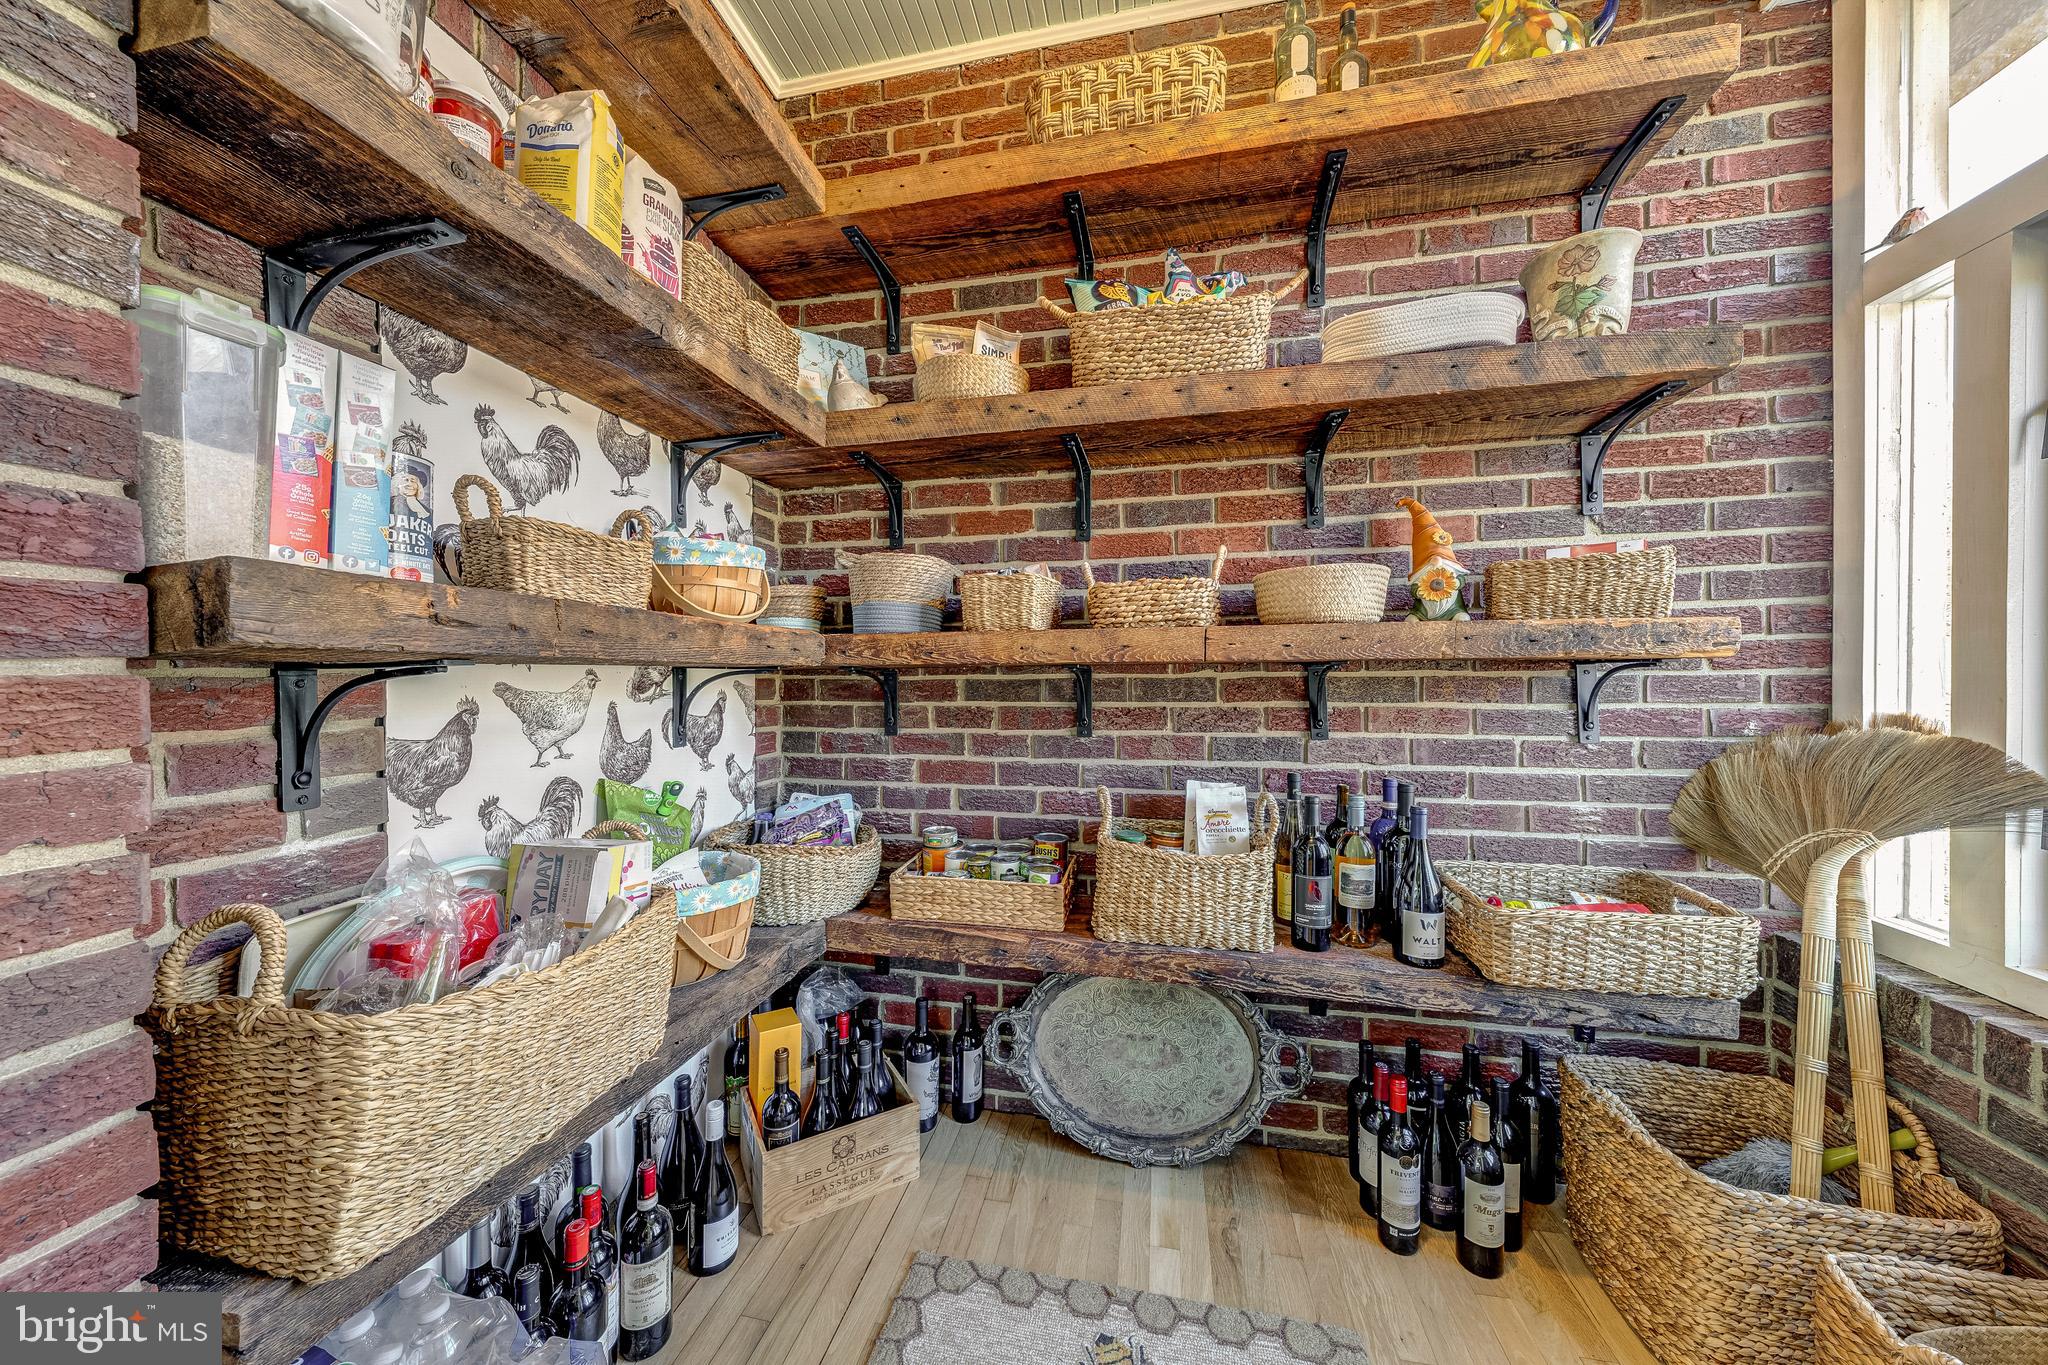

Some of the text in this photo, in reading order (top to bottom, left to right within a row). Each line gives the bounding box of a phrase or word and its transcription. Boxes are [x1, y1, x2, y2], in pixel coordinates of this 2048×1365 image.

[389, 513, 433, 538] UAKER
[388, 542, 412, 553] TEEL
[1035, 846, 1058, 857] BUSH'S
[529, 851, 554, 916] RYDAY
[1412, 935, 1441, 946] WALT
[796, 1144, 889, 1184] LES CADRANS
[1389, 1168, 1420, 1178] TRIVENT
